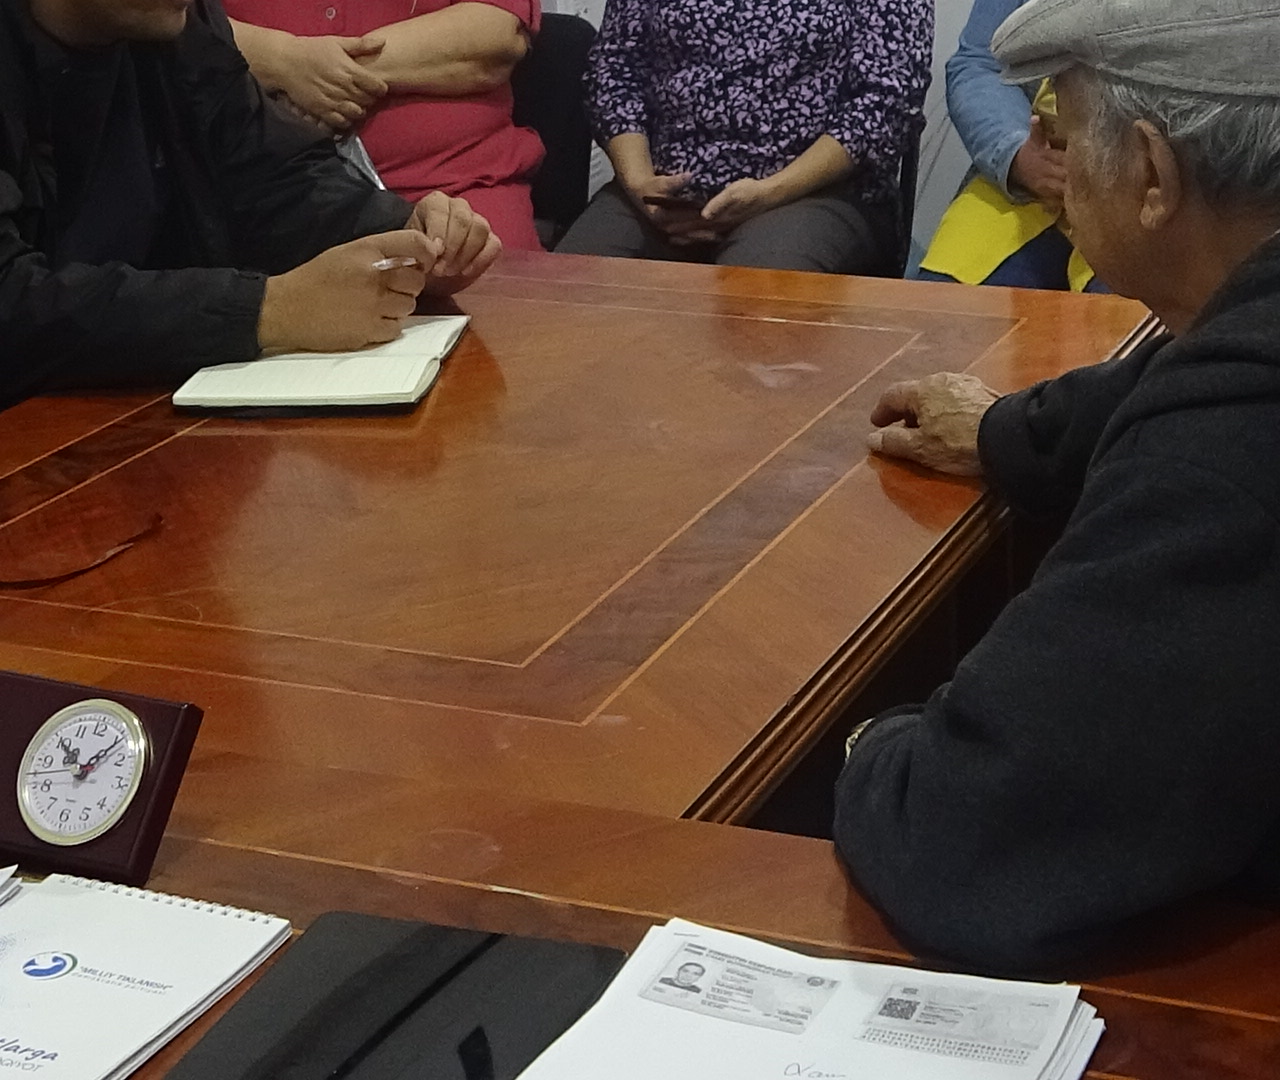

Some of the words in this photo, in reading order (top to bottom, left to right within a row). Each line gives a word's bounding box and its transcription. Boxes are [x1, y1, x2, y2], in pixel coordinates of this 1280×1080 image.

[75, 725, 86, 739] 11
[92, 722, 108, 737] 12
[42, 755, 54, 769] 9
[114, 753, 125, 766] 2
[40, 779, 52, 792] 8
[47, 797, 57, 810] 7
[97, 796, 107, 810] 4
[59, 808, 71, 822] 6
[79, 807, 92, 821] 5
